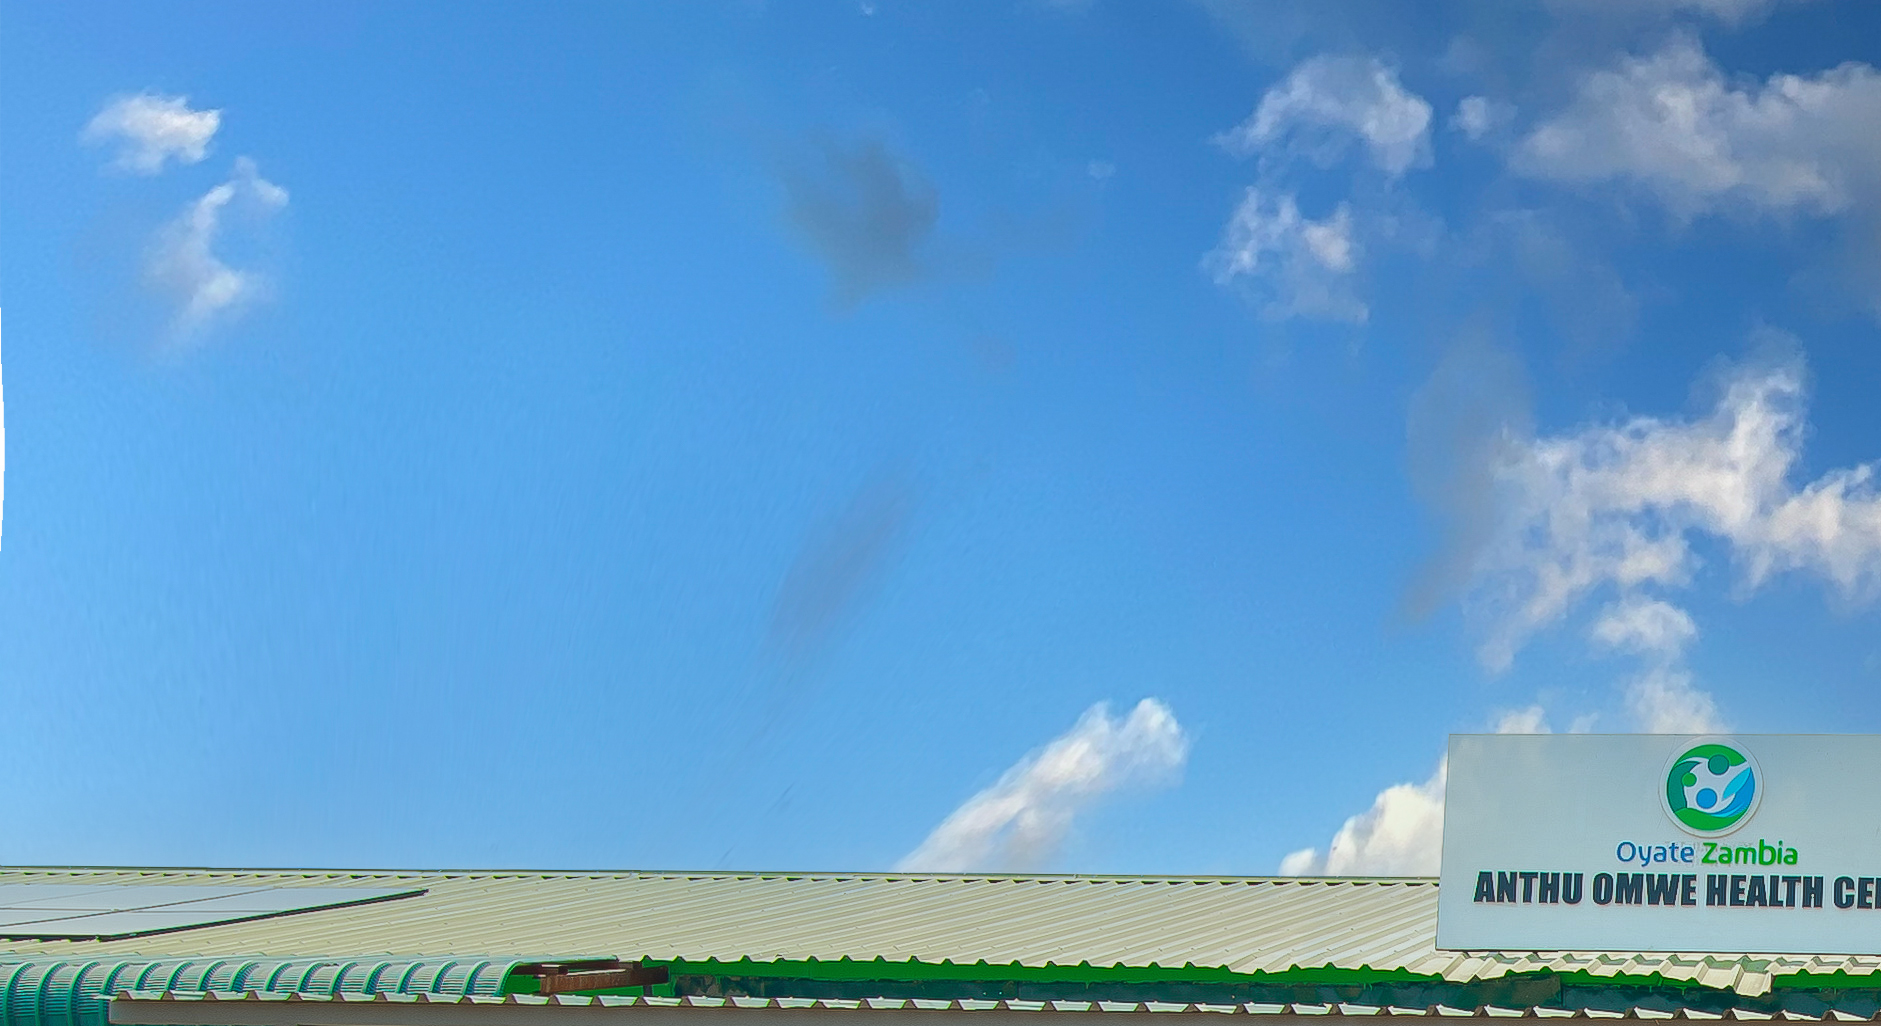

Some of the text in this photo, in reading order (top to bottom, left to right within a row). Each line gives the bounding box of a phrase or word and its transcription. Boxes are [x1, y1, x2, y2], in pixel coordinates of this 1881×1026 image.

[1616, 838, 1798, 867] Oyate Zambia
[1473, 871, 1584, 905] ANTHU
[1592, 872, 1697, 906] OMWE
[1706, 874, 1824, 908] HEALTH
